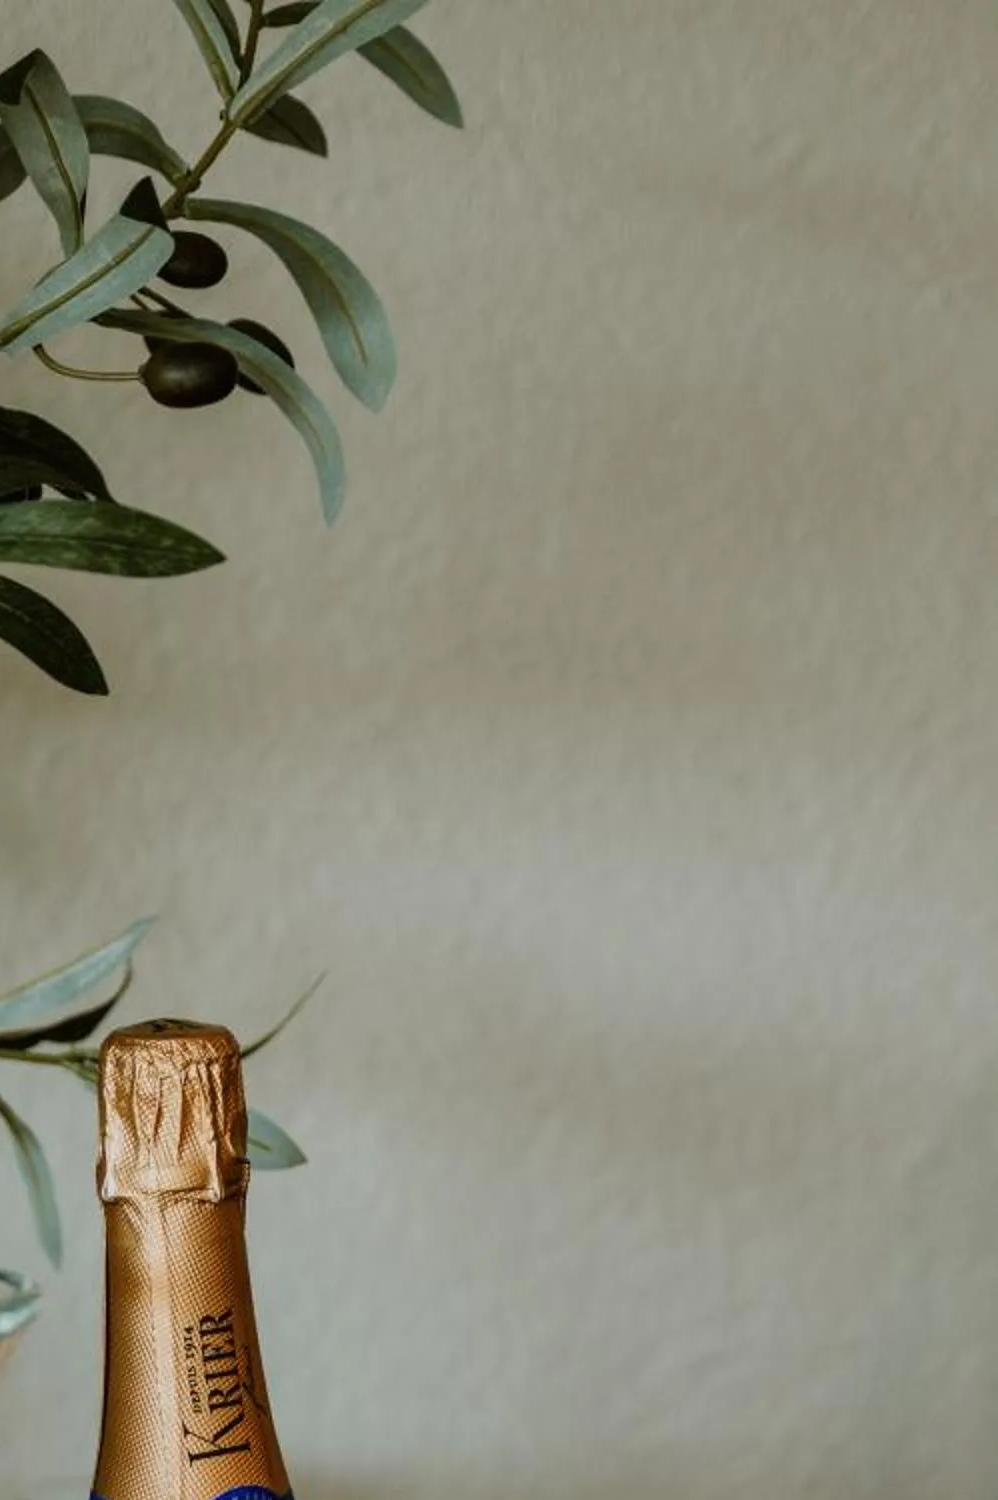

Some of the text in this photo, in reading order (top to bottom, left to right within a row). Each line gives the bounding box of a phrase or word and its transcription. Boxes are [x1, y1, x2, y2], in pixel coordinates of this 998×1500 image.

[182, 1308, 252, 1468] KRIER
[183, 1326, 202, 1414] DEPUIS 1914
